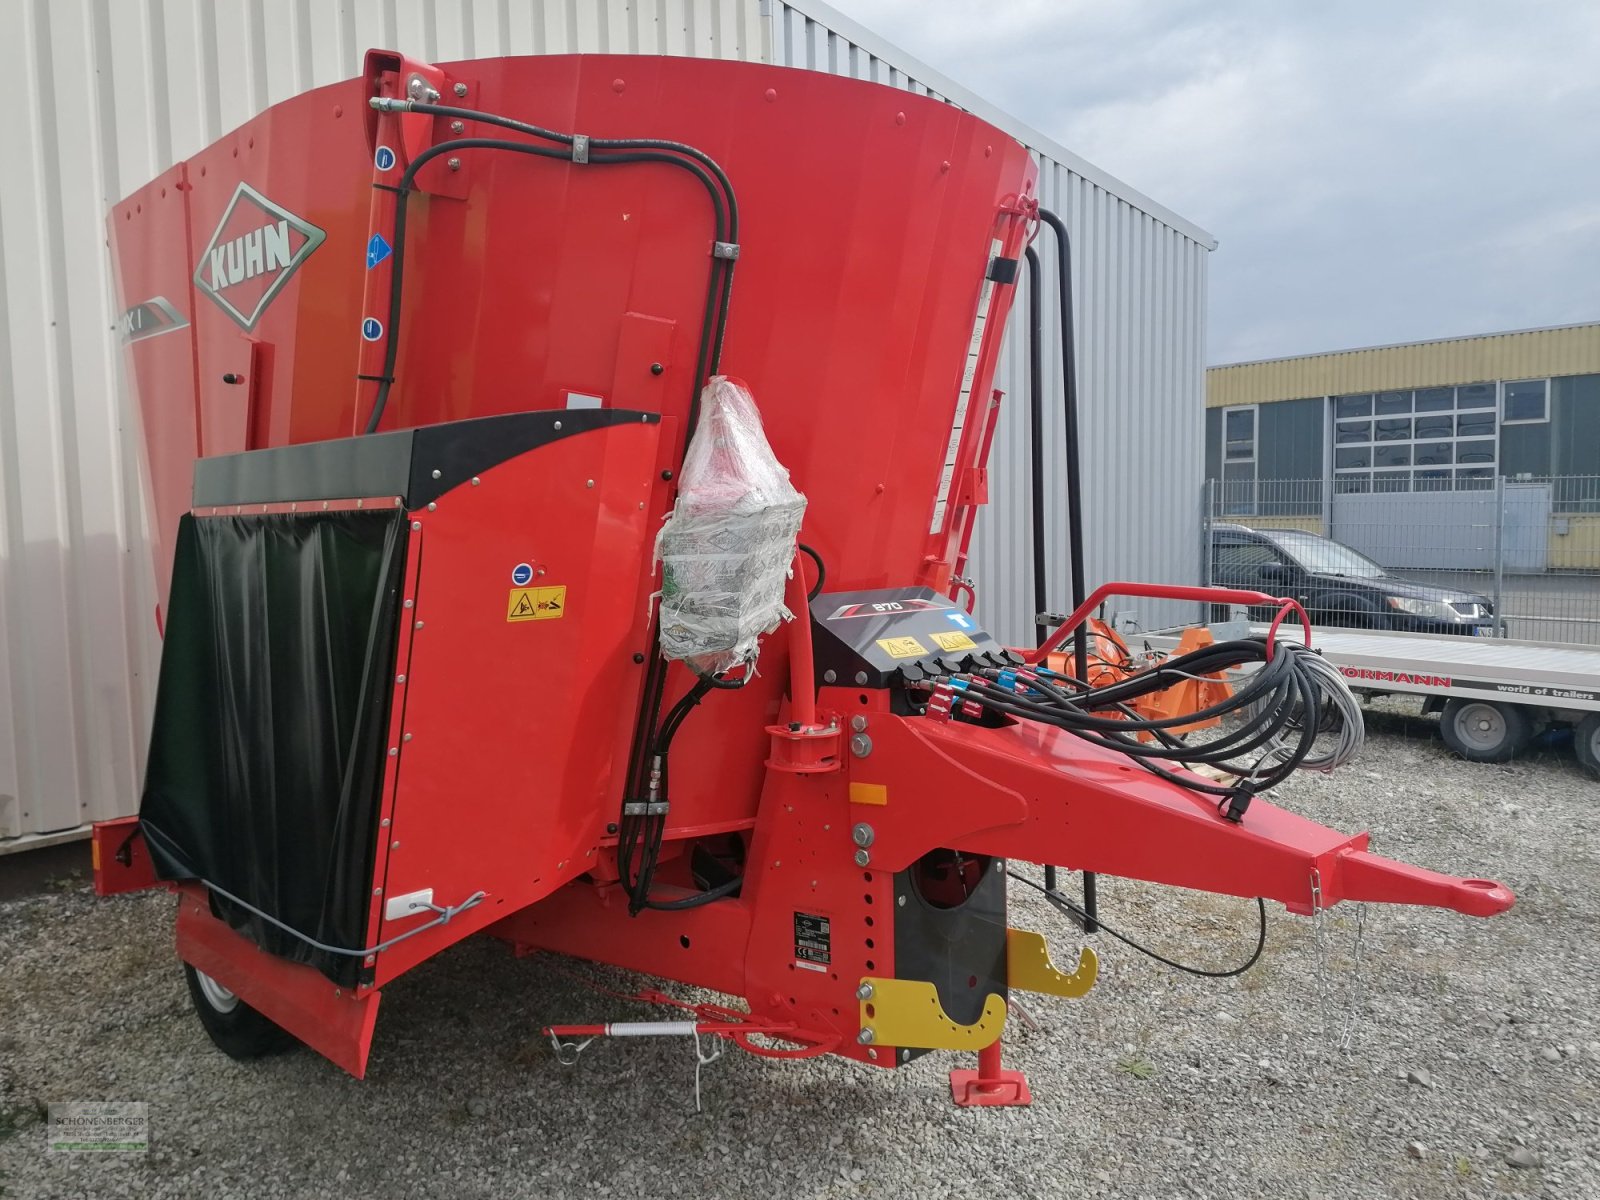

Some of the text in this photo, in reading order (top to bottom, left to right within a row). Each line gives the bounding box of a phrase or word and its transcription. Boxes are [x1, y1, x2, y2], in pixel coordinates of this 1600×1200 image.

[209, 219, 292, 292] KUHN
[872, 602, 904, 612] 870
[946, 613, 971, 628] T
[1497, 685, 1595, 700] world of trailers
